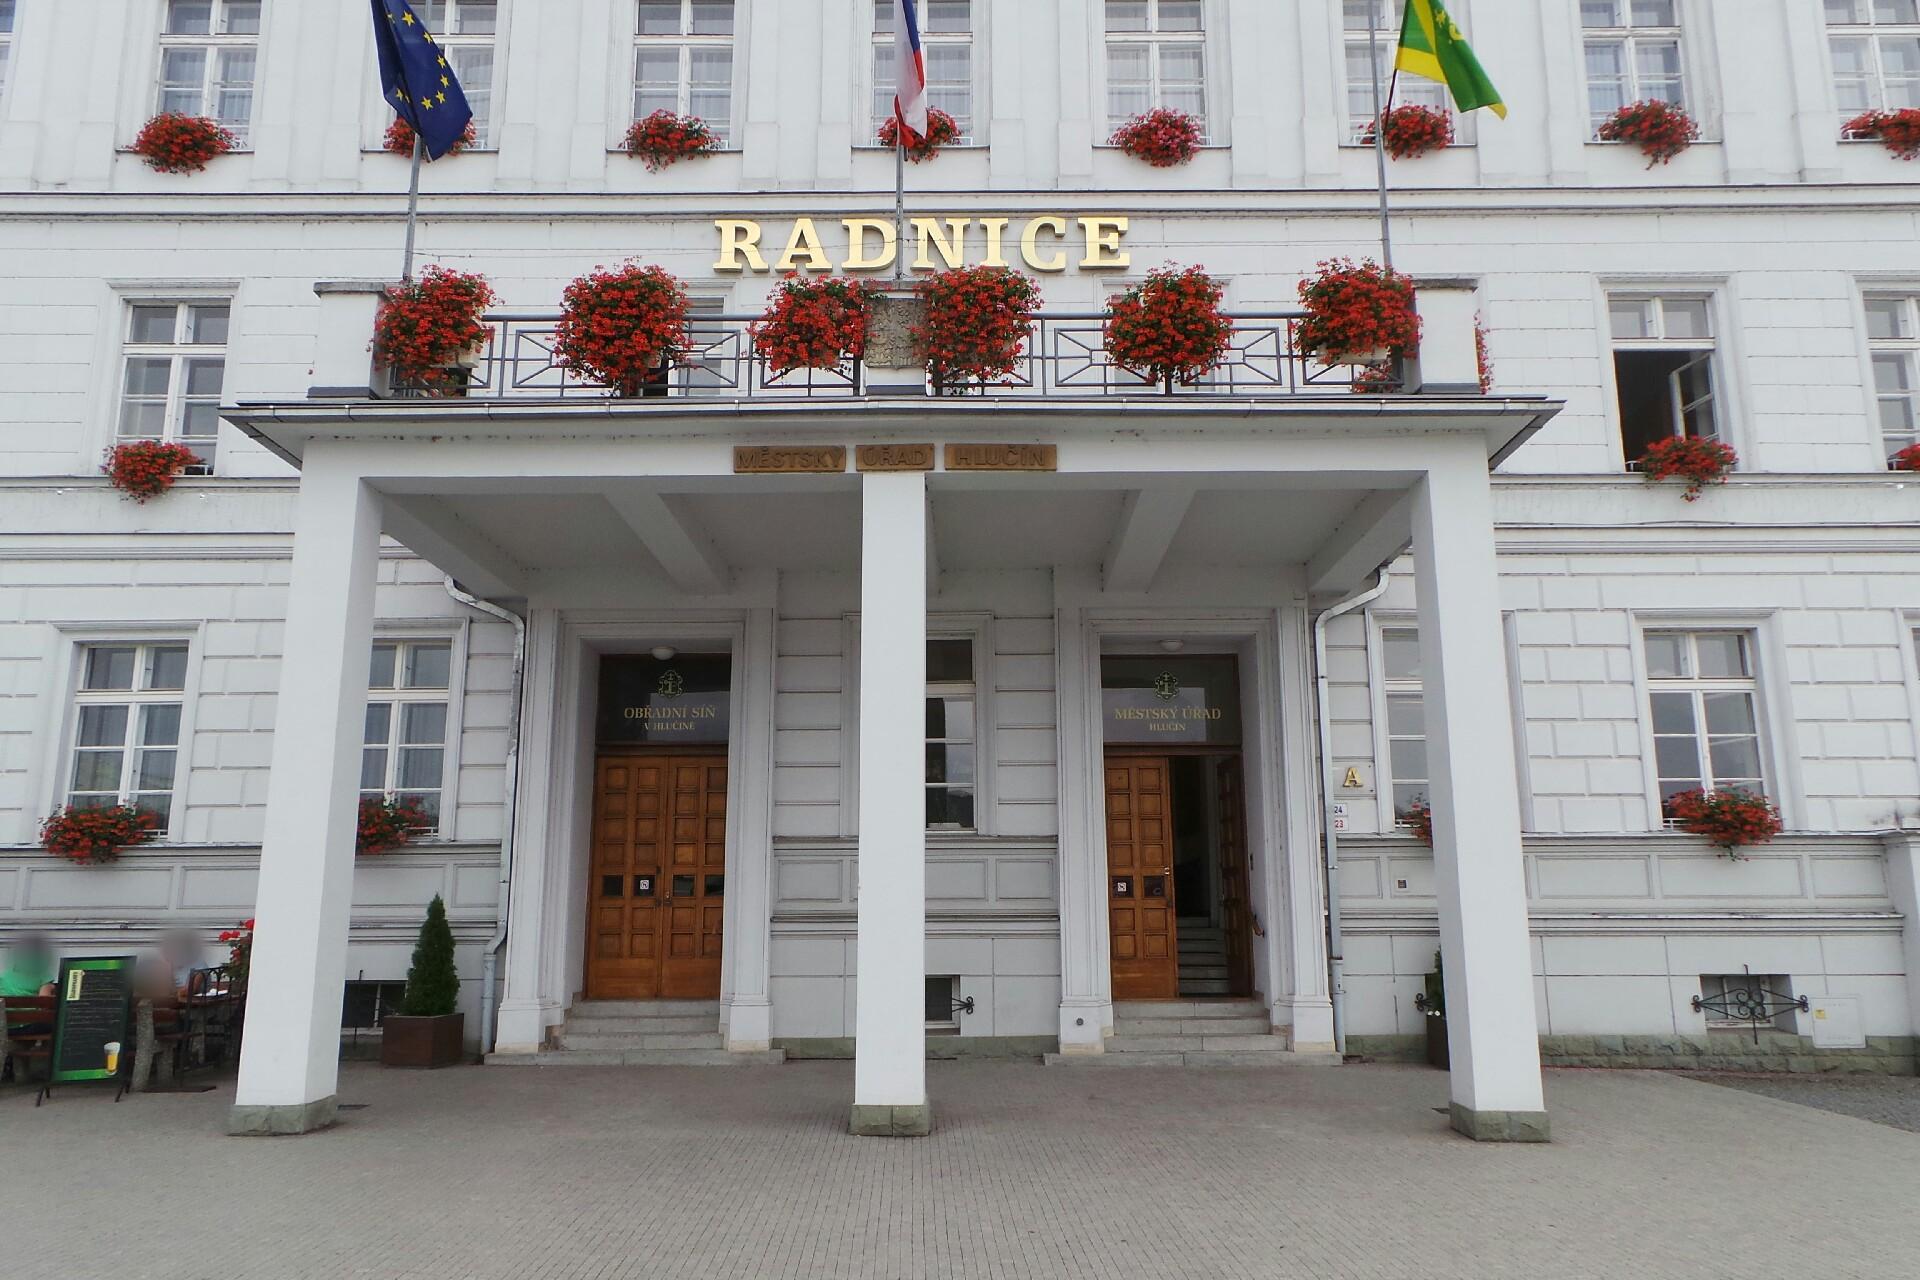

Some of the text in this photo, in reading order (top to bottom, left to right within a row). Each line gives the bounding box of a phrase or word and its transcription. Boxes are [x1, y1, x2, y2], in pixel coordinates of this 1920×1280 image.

[712, 216, 1130, 272] RADNICE
[624, 705, 689, 719] OBŘADNÍ
[1342, 767, 1363, 788] A
